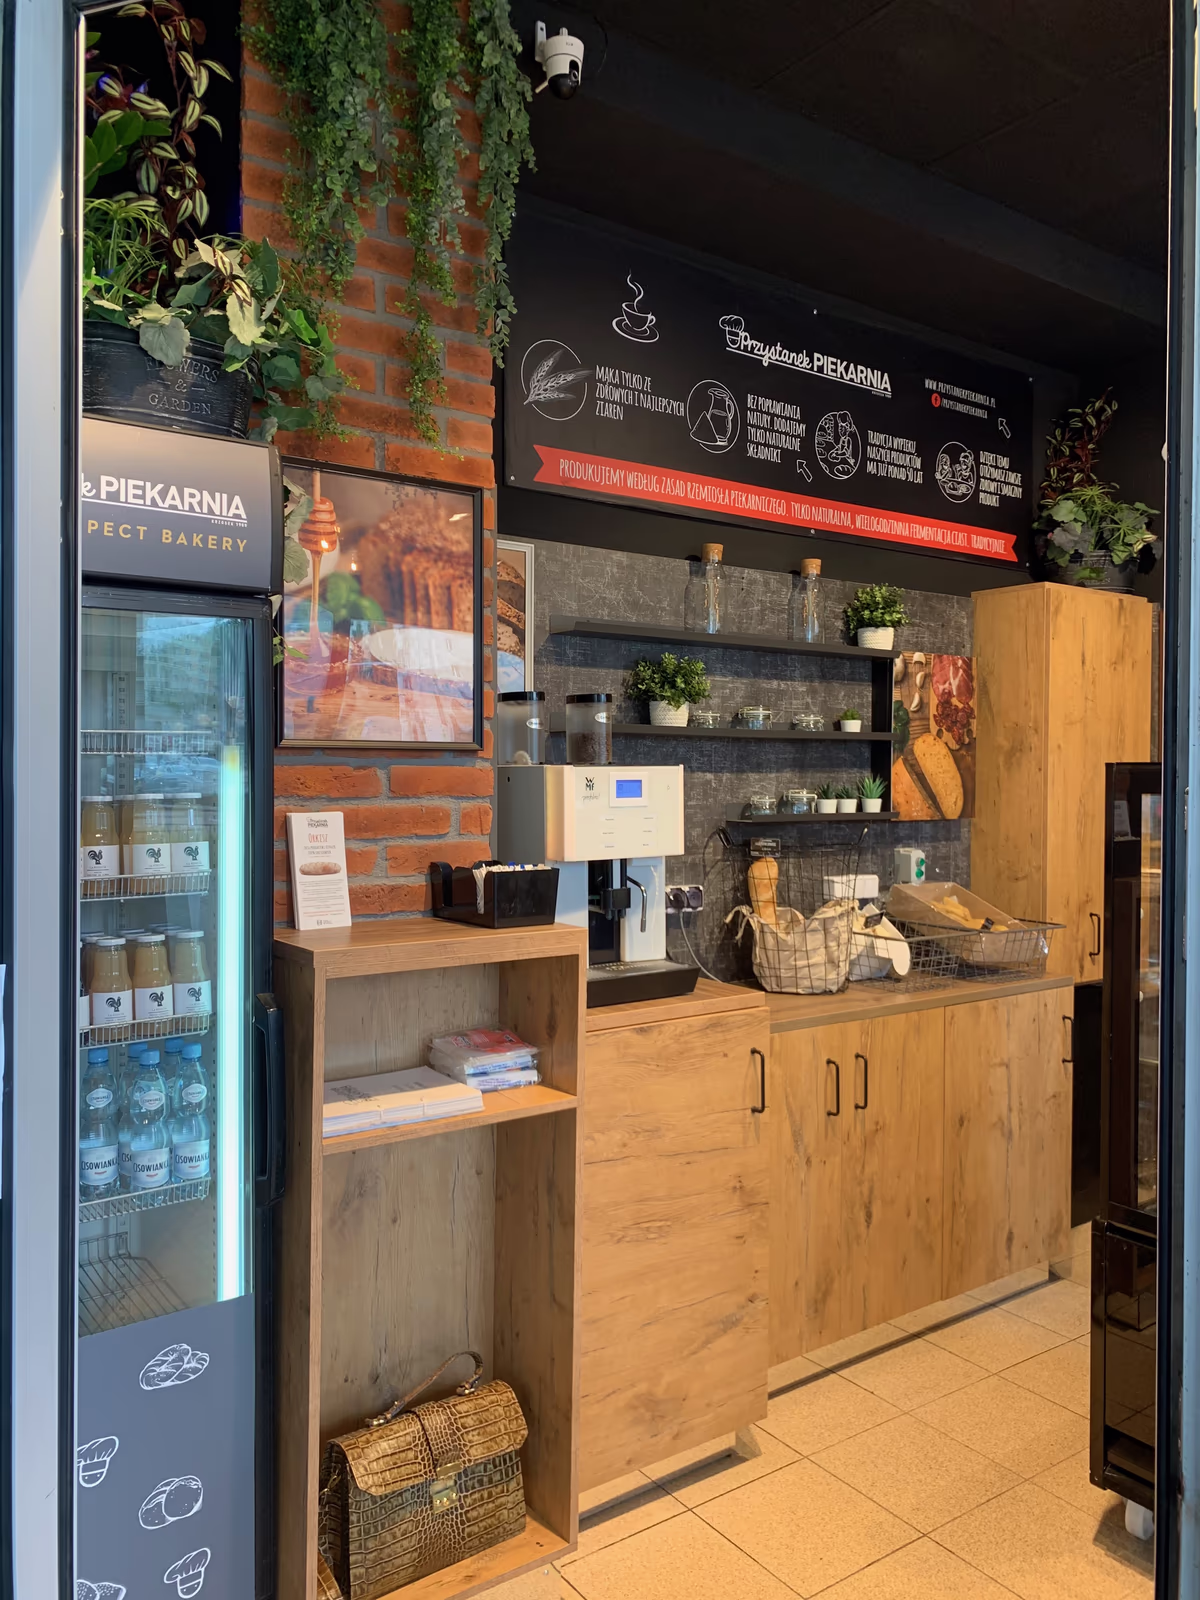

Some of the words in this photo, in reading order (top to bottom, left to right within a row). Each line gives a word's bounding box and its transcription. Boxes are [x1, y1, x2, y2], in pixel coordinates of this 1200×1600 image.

[740, 331, 812, 367] Przystanek
[813, 352, 892, 392] PIEKARNIA
[175, 378, 187, 392] &
[595, 364, 619, 386] MĄKA
[621, 370, 643, 390] TYLKO
[644, 376, 652, 392] ZE
[148, 393, 212, 415] GARDEN
[595, 382, 633, 405] ZDROWYCH
[635, 391, 639, 407] I
[640, 392, 685, 417] NAJLEPSZYCH
[595, 400, 624, 420] ZIAREN
[747, 393, 758, 409] BEZ
[758, 396, 801, 420] POPRAWIANIA
[747, 410, 773, 429] NATURY.
[774, 416, 807, 437] DODAJEMY
[747, 426, 766, 444] TYLKO
[766, 430, 801, 452] NATURALNE
[746, 442, 781, 463] SKŁADNIKI
[867, 460, 877, 475] MA
[888, 464, 907, 481] PONAD
[914, 470, 923, 484] LAT
[100, 475, 247, 519] PIEKARNIA
[559, 458, 625, 487] PRODUKUJEMY
[626, 470, 660, 493] WEDŁUG
[661, 477, 686, 497] ZASAD
[686, 481, 730, 506] RZEMIOSŁA
[730, 490, 789, 517] PIEKARNICZEGO.
[791, 501, 811, 521] TYLKO
[811, 506, 855, 530] NATURALNA,
[855, 514, 910, 537] WIELOGODZINNA
[161, 529, 248, 552] BAKERY
